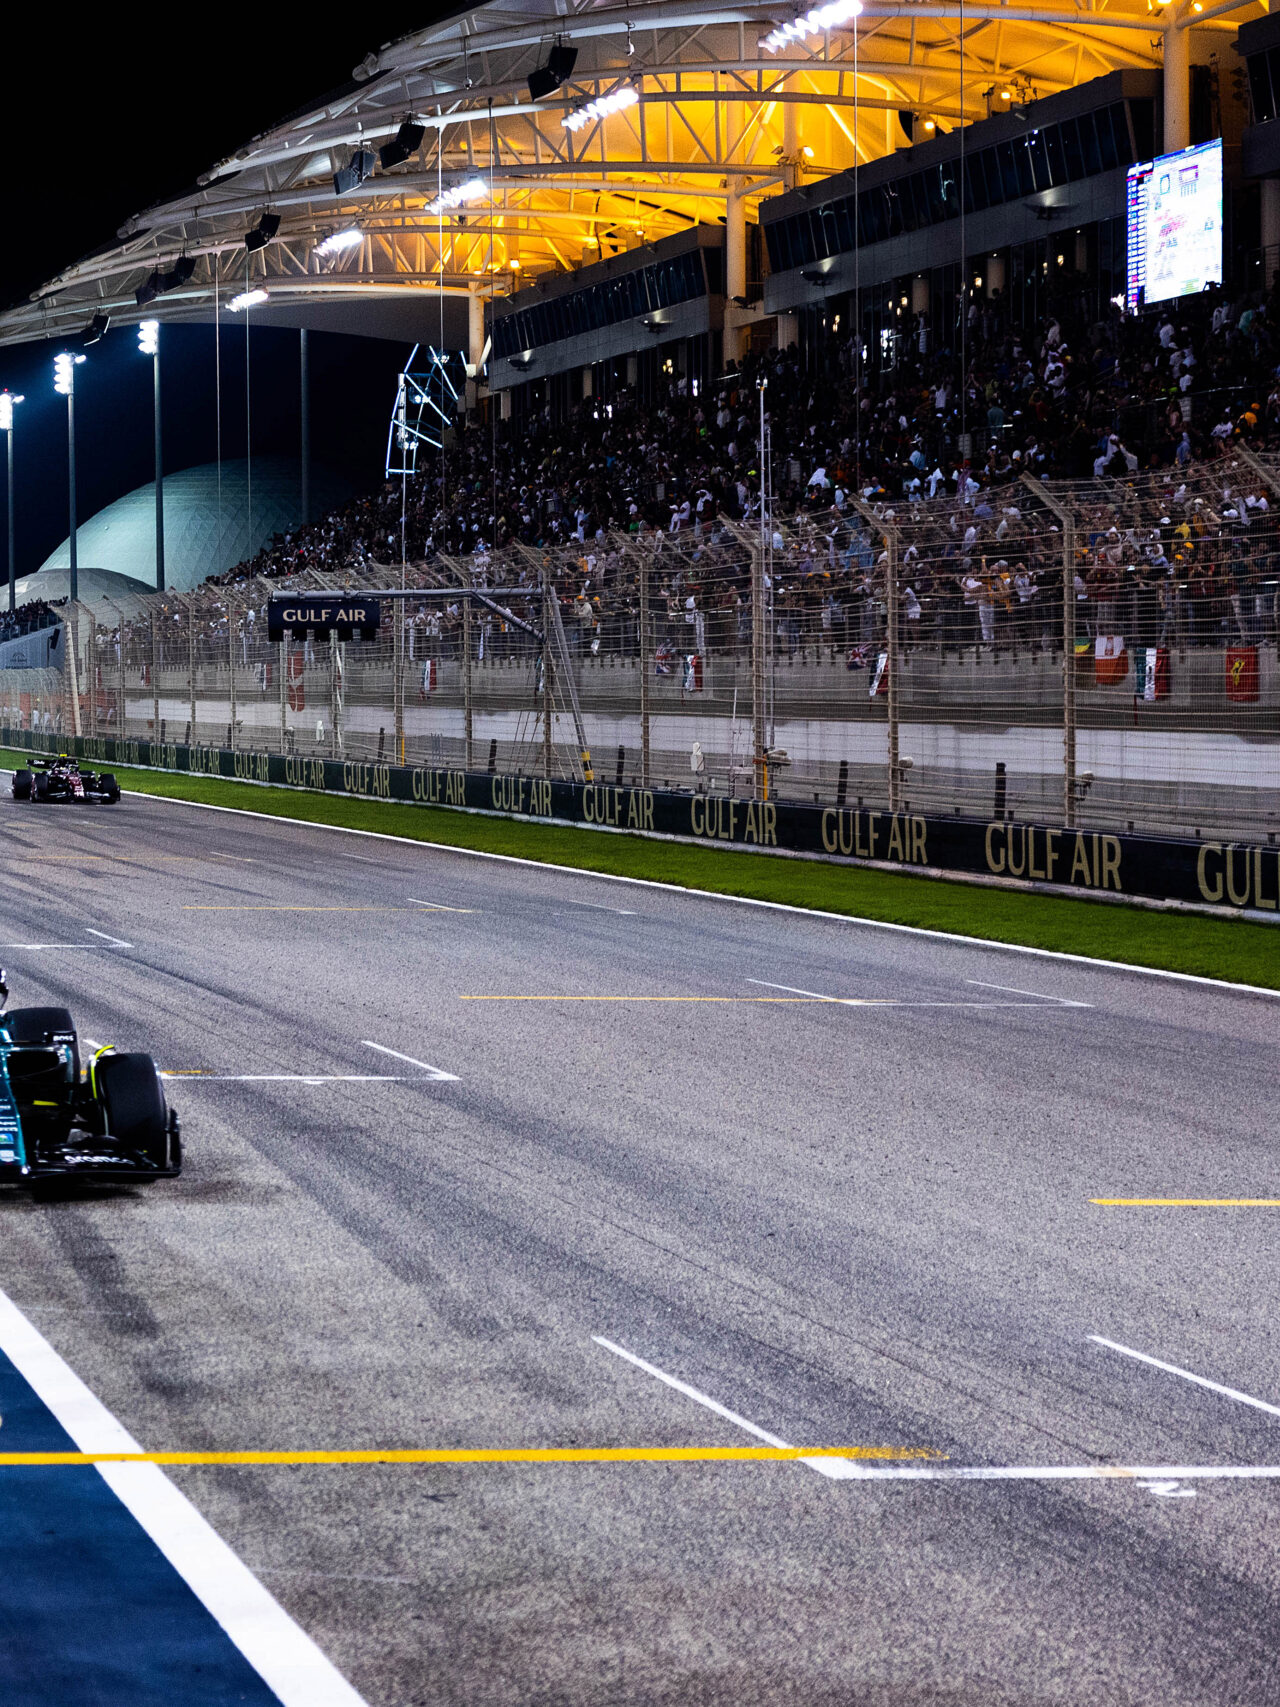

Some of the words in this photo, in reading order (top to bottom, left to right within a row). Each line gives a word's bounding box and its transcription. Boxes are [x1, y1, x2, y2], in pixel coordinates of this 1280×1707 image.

[283, 609, 331, 621] GULF
[336, 609, 365, 621] AIR
[189, 747, 208, 772] GULF
[209, 748, 219, 774] AIR
[234, 752, 254, 778] GULF
[256, 754, 269, 781] AIR
[285, 757, 307, 785] GULF
[310, 760, 325, 788] AIR
[343, 762, 370, 793] GULF
[372, 766, 390, 797] AIR
[412, 768, 442, 801] GULF
[446, 770, 465, 805] AIR
[492, 775, 526, 811] GULF
[529, 780, 552, 816] AIR
[583, 785, 623, 825] GULF
[628, 790, 654, 830] AIR
[691, 797, 740, 840] GULF
[745, 801, 777, 846] AIR
[822, 808, 882, 858] GULF
[888, 816, 928, 865] AIR
[986, 822, 1062, 881] GULF
[1071, 832, 1122, 890] AIR
[1197, 842, 1280, 909] GUL
[64, 1155, 135, 1165] aramco
